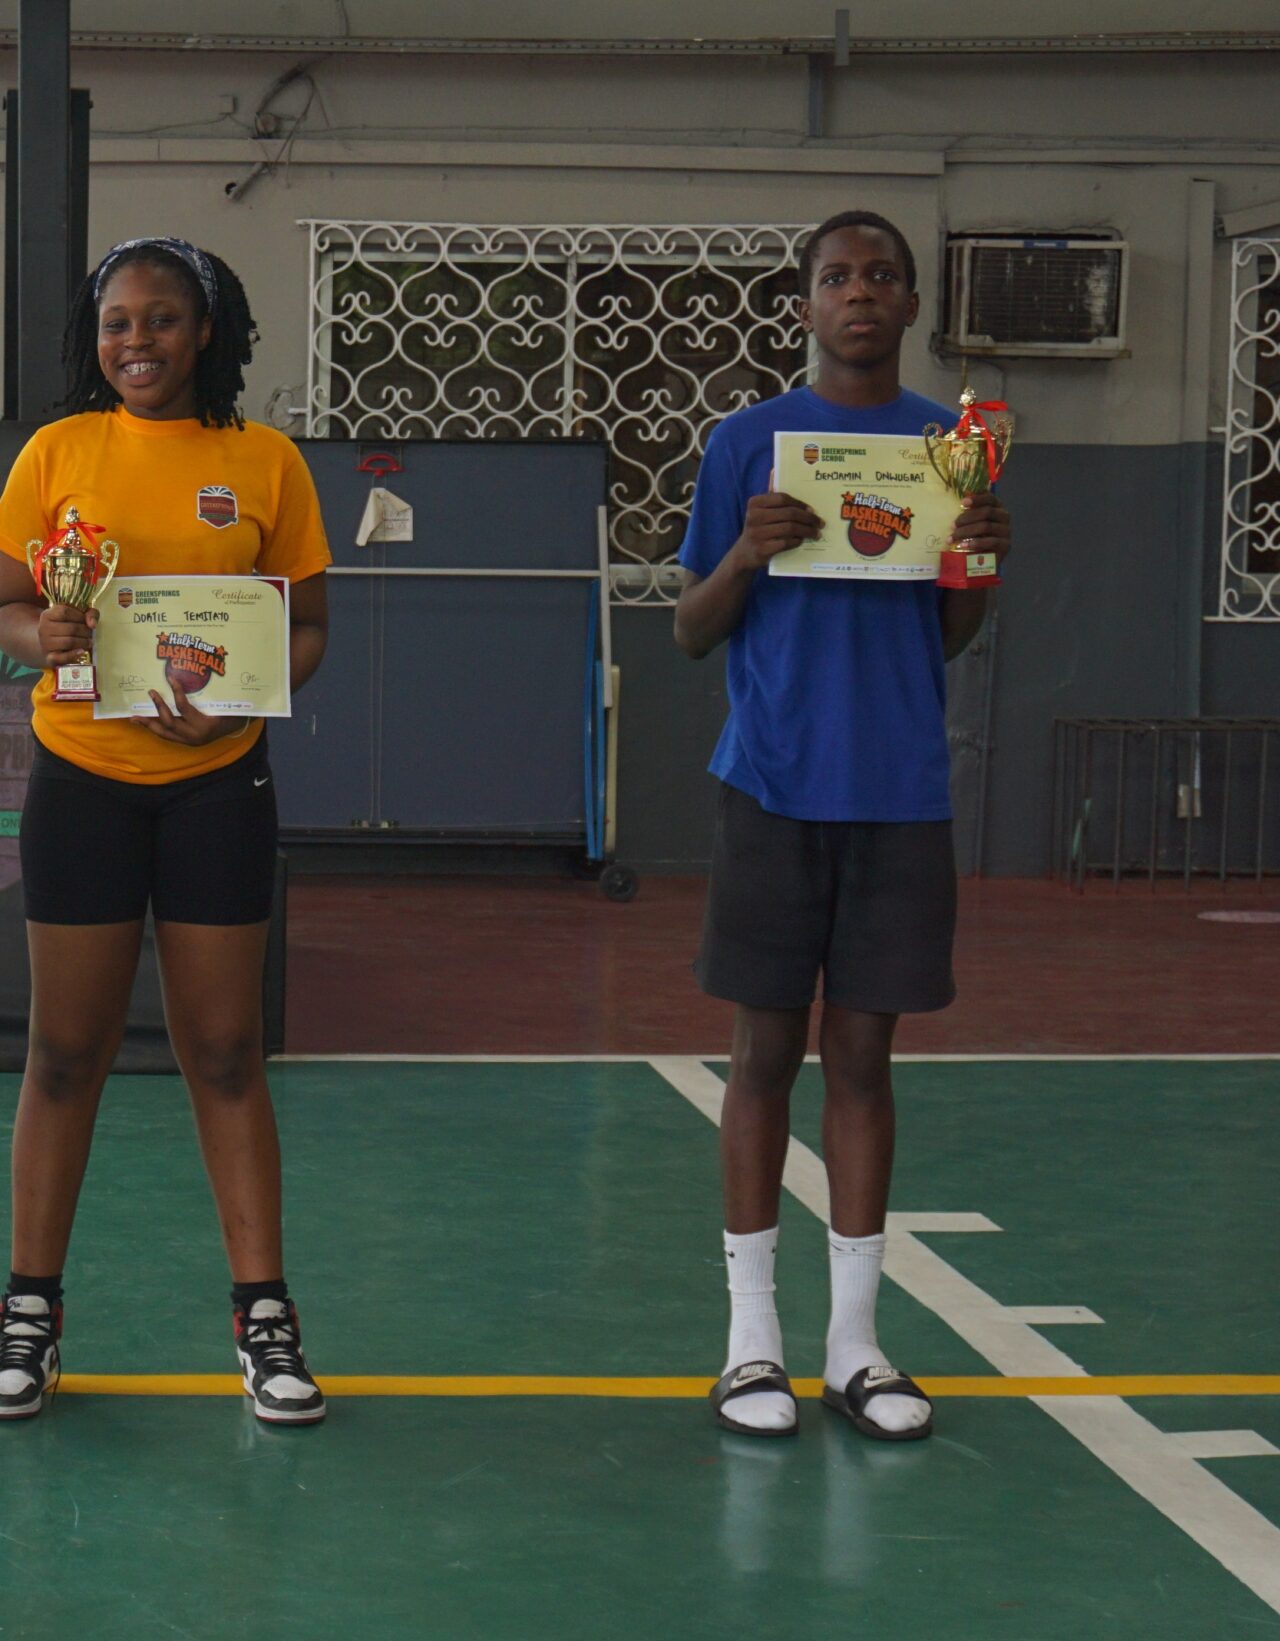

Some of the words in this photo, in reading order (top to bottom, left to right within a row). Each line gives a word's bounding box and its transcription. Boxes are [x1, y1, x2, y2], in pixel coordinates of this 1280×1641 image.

[822, 448, 867, 456] GREENSPRINGS
[816, 471, 862, 481] BENJAMIN
[855, 493, 902, 516] Half-Term
[843, 505, 912, 539] BASKETBALL
[855, 520, 892, 538] CLINIC
[212, 589, 262, 603] Certificate
[169, 633, 216, 654] Half-Term
[159, 645, 226, 676] BASKETBALL
[172, 658, 207, 677] CLINIC
[2, 818, 21, 829] ON
[739, 1365, 774, 1380] NIKE
[869, 1367, 901, 1380] NIKE
